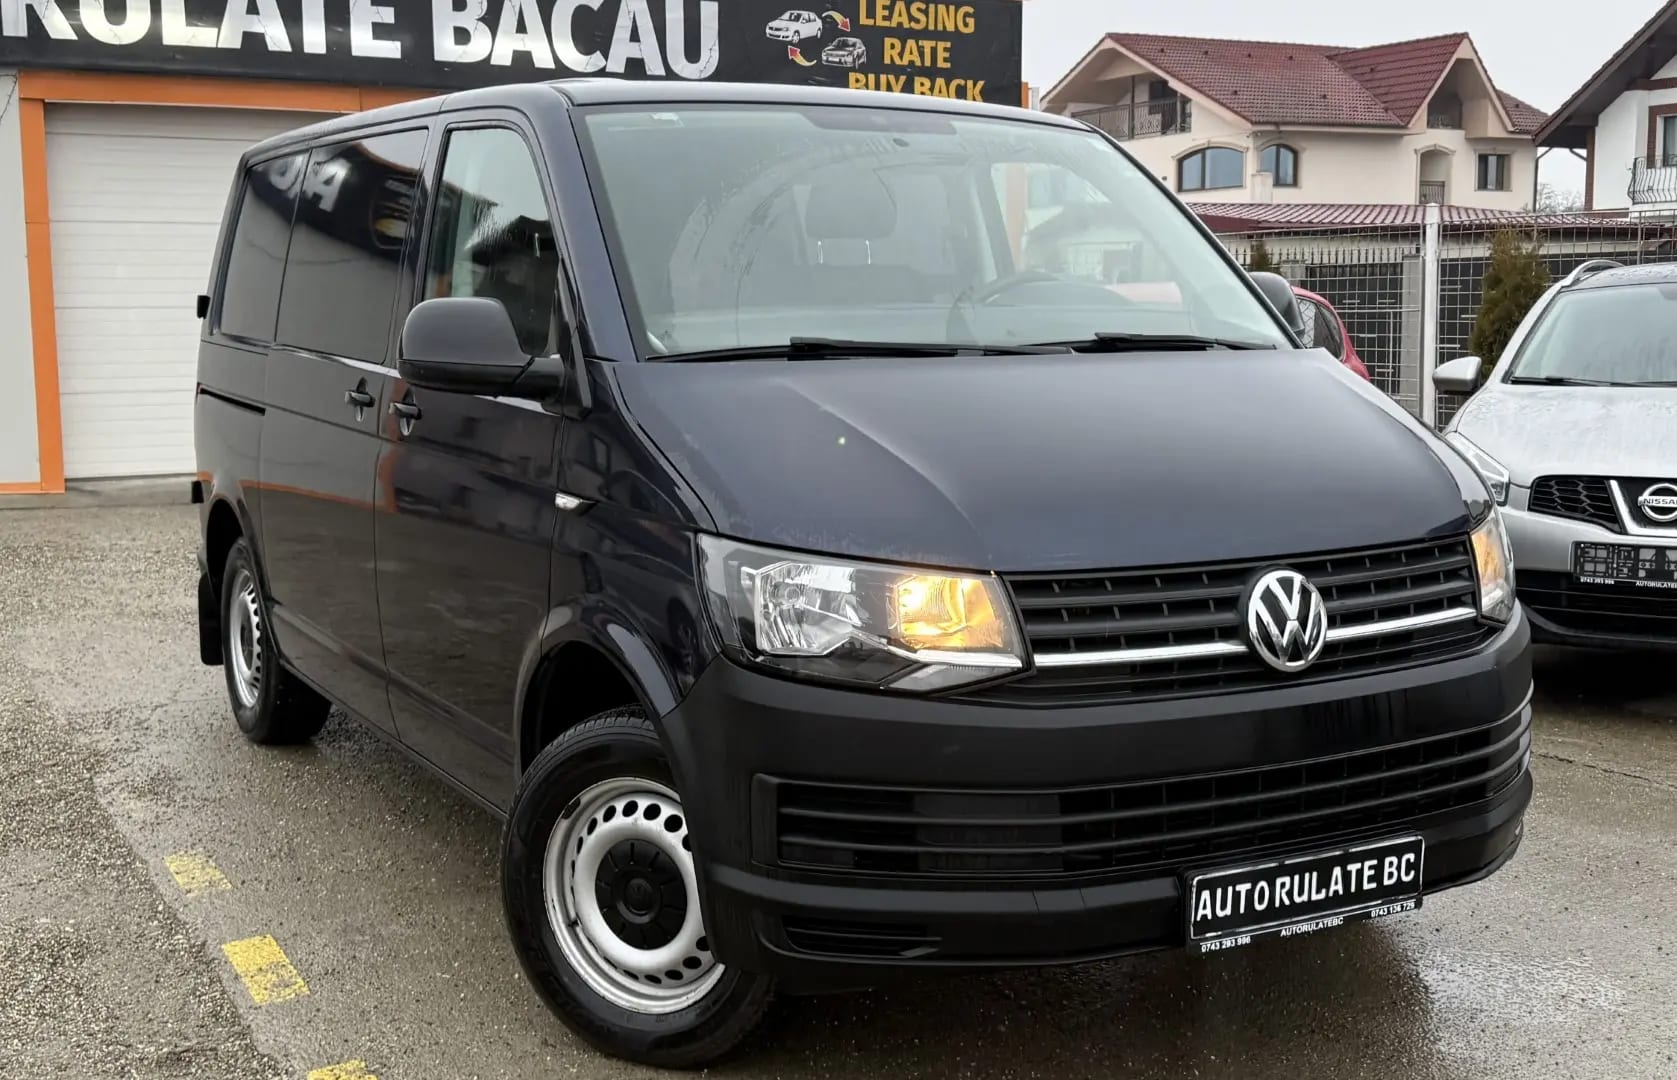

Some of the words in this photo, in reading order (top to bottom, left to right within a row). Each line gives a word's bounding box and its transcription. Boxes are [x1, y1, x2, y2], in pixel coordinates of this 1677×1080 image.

[859, 0, 975, 34] LEASING
[433, 0, 720, 79] BACAU
[883, 37, 951, 68] RATE
[848, 72, 907, 93] BUY
[914, 76, 985, 103] BACK
[1196, 880, 1270, 921] AUTO
[1275, 859, 1378, 908] RULATE
[1383, 852, 1415, 886] BC
[1280, 916, 1344, 937] AUTORULATEBC
